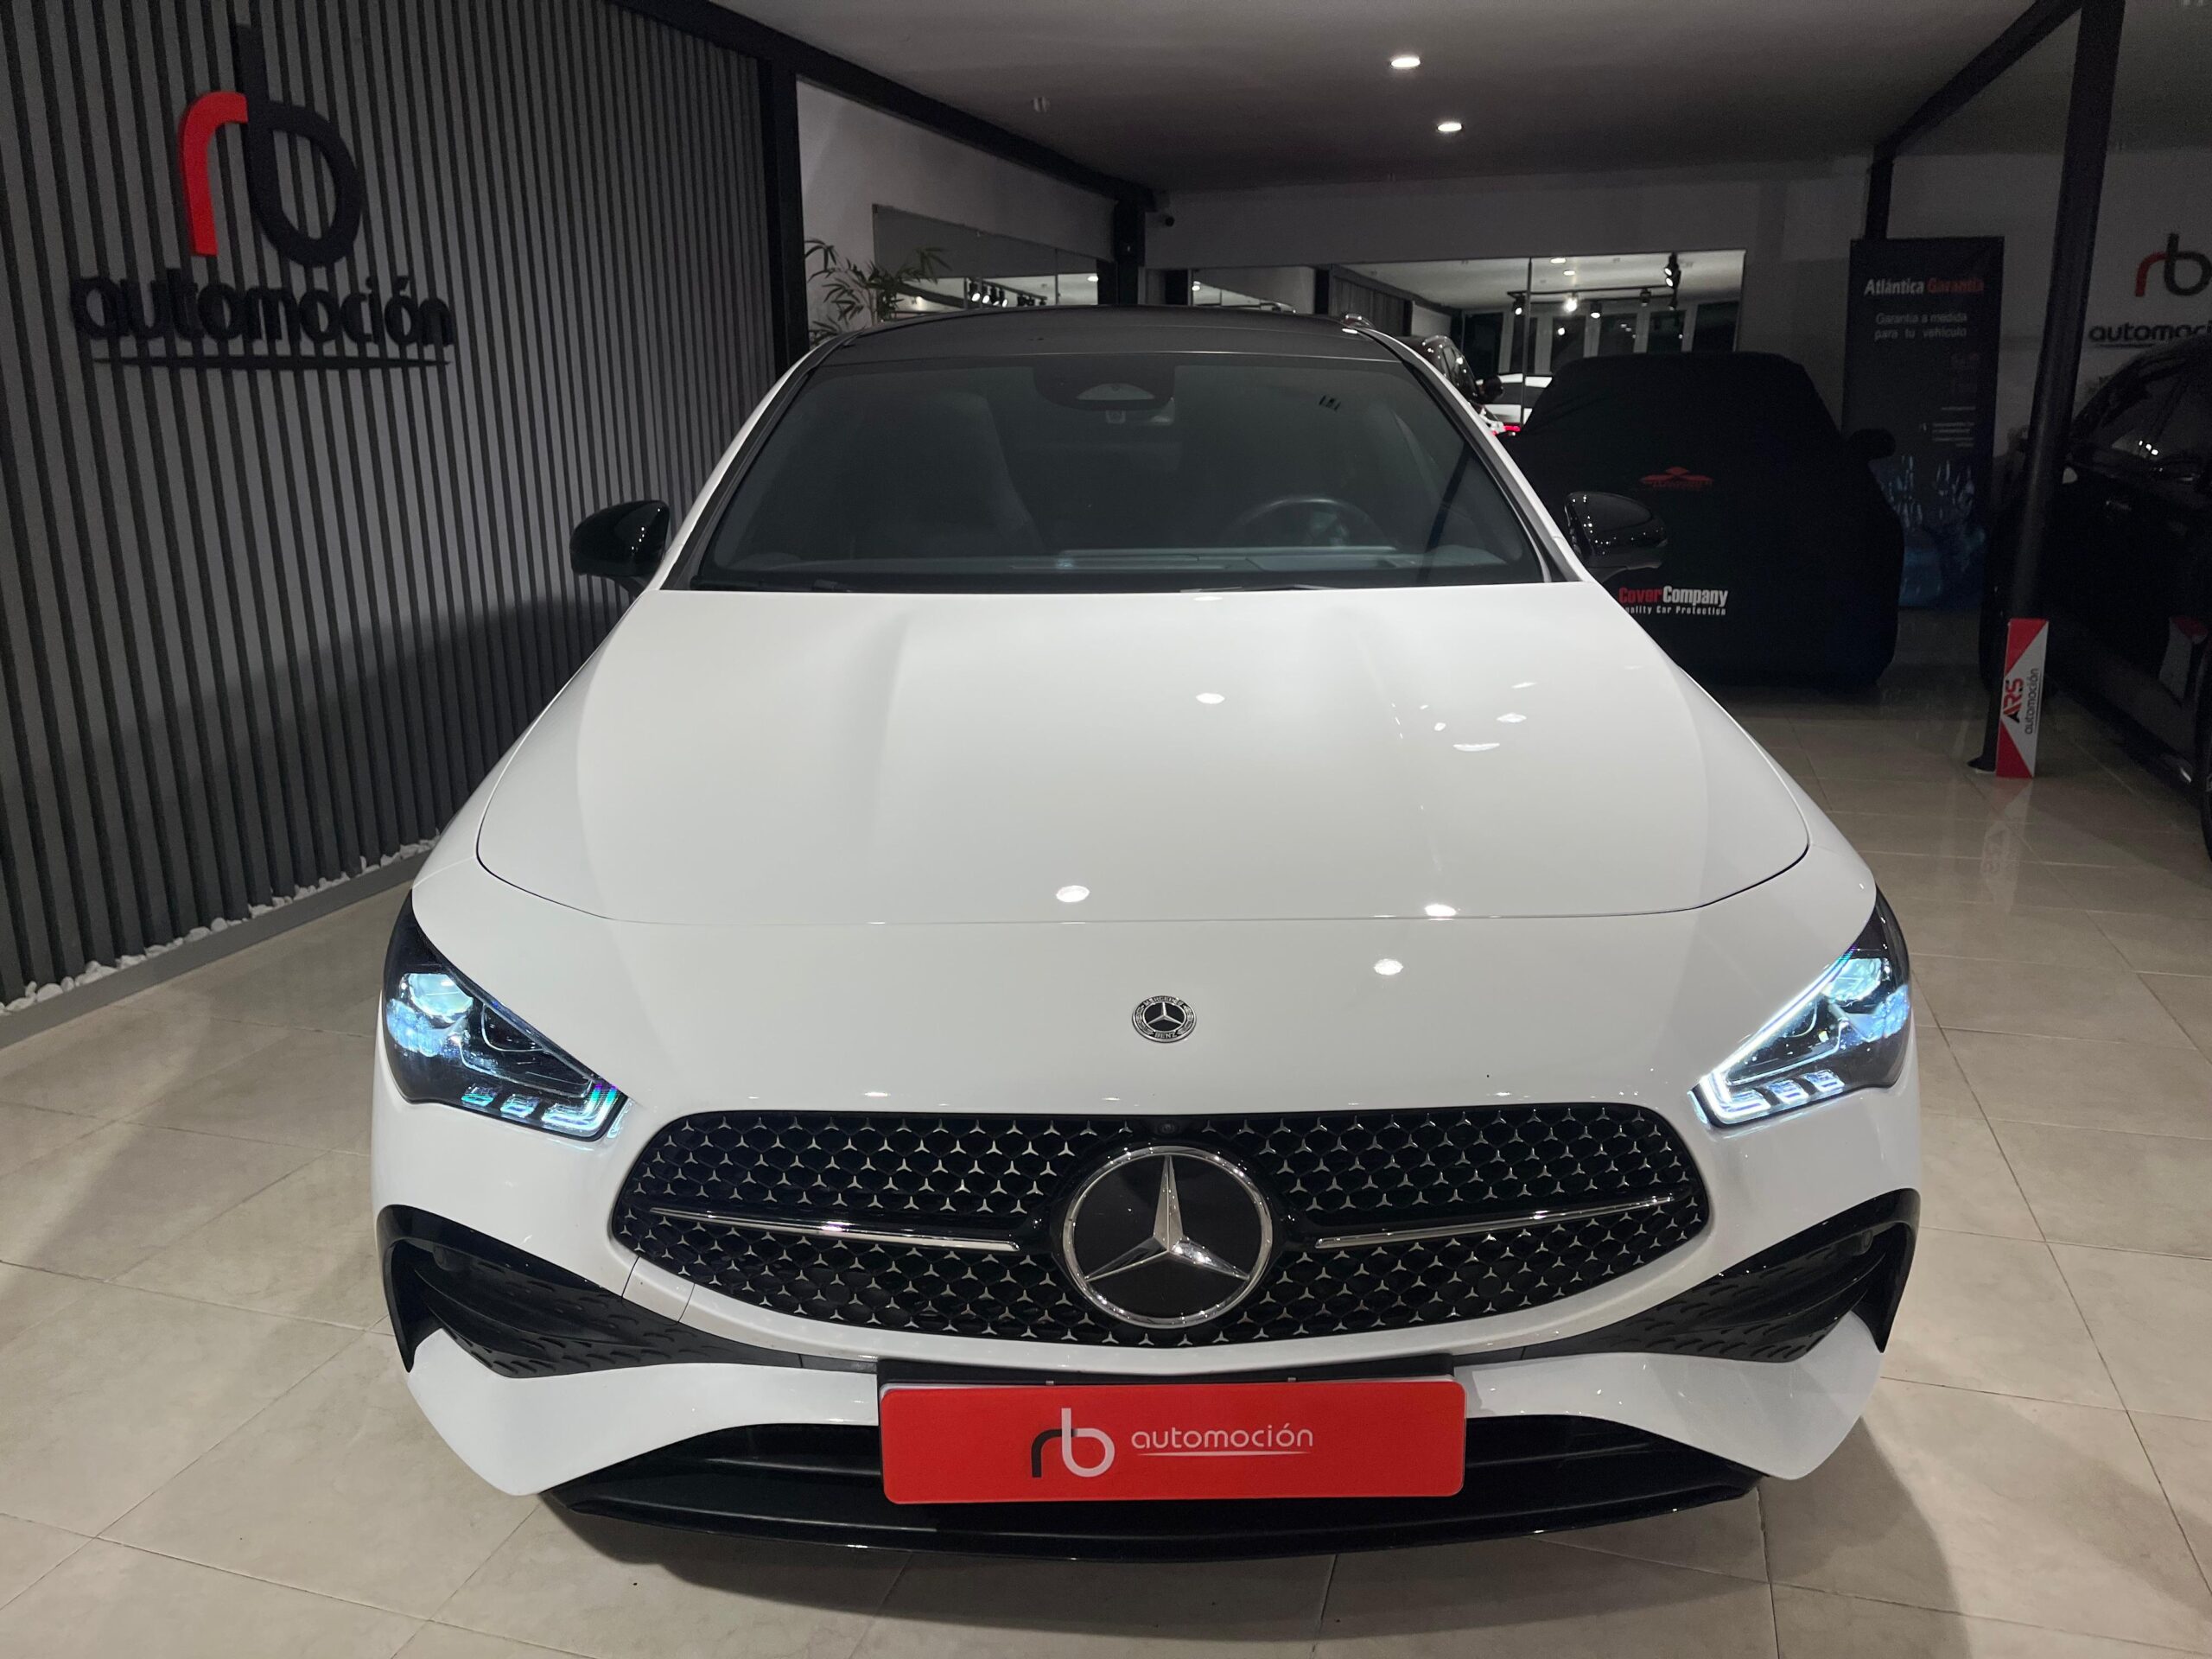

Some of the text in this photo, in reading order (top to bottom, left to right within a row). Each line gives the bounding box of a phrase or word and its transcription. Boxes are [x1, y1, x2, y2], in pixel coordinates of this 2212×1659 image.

[1864, 278, 1925, 296] Atlántica
[71, 268, 454, 346] automoción
[1921, 314, 1929, 323] a
[1874, 329, 1899, 342] para
[1904, 327, 1916, 339] tu
[1624, 605, 1726, 615] uality Car Protection
[2003, 677, 2024, 724] ARS
[2024, 667, 2040, 735] automoción
[1154, 1031, 1178, 1039] BENZ
[1031, 1407, 1313, 1478] rb automoción
